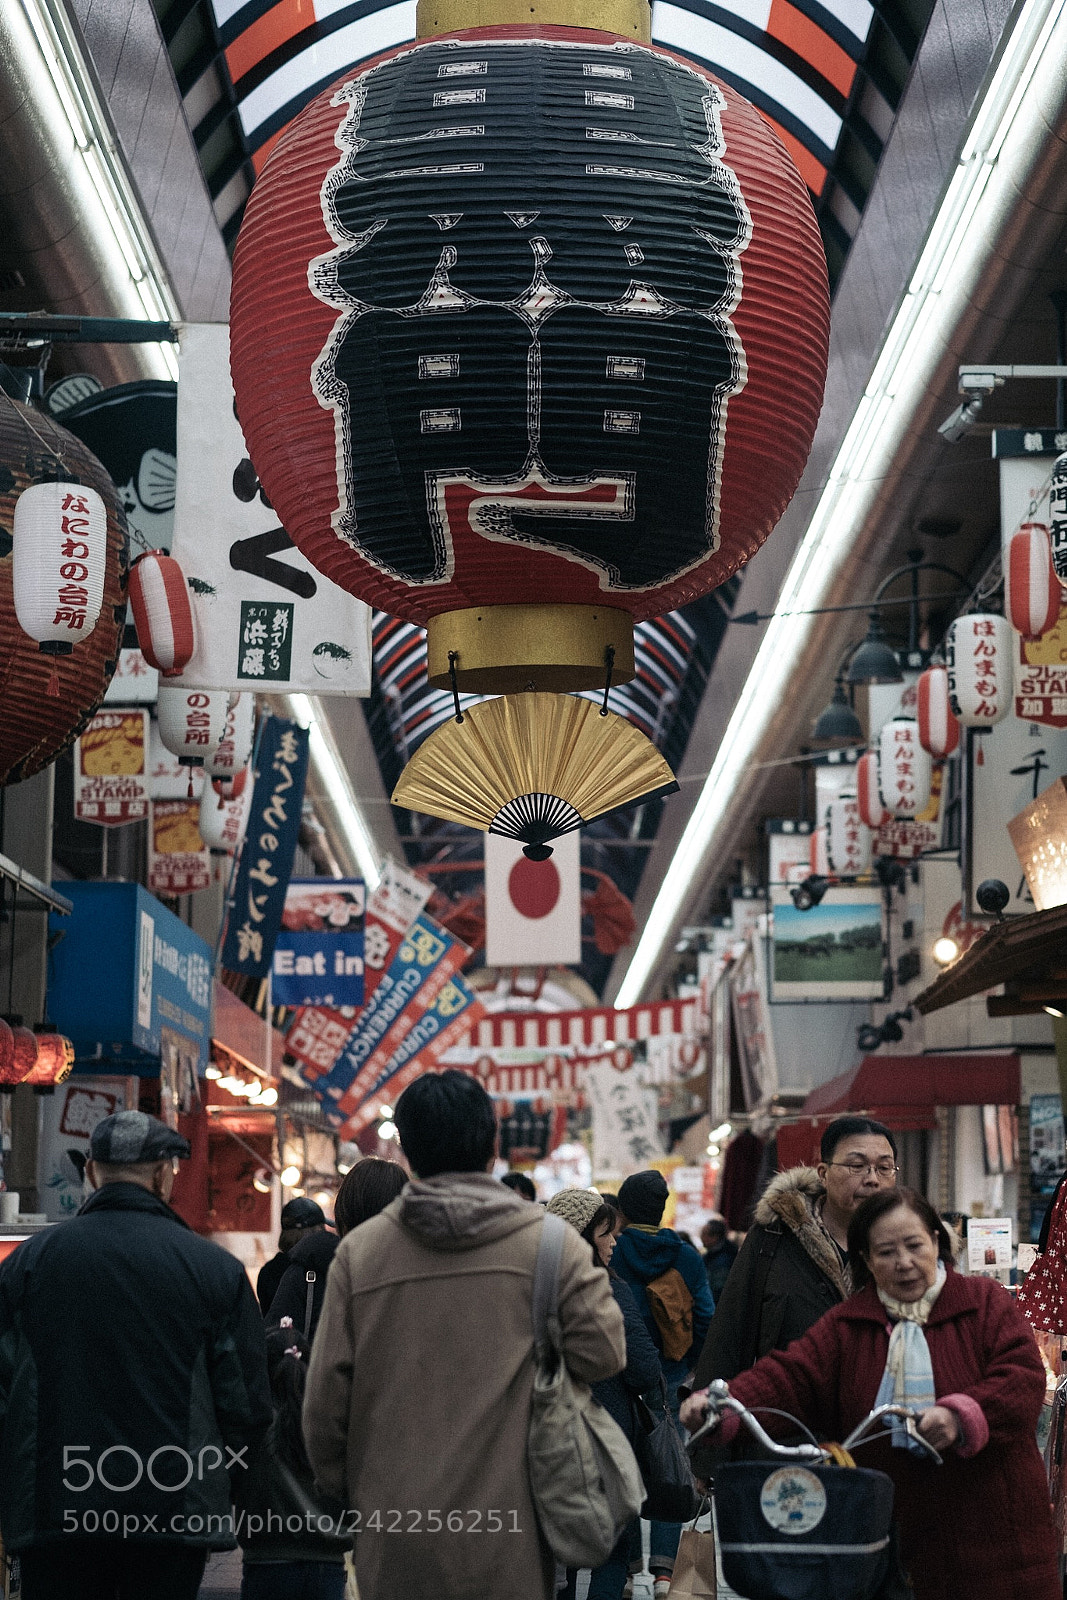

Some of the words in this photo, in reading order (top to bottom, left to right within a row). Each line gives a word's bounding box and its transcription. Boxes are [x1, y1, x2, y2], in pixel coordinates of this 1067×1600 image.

[53, 493, 90, 629] なにわの台所
[973, 621, 997, 717] ほんまもん
[1021, 680, 1067, 693] STA
[81, 787, 144, 798] STAMP
[894, 729, 916, 810] ほんまもん
[273, 949, 326, 976] Eat
[335, 949, 364, 976] in
[347, 968, 421, 1069] CURRENCY
